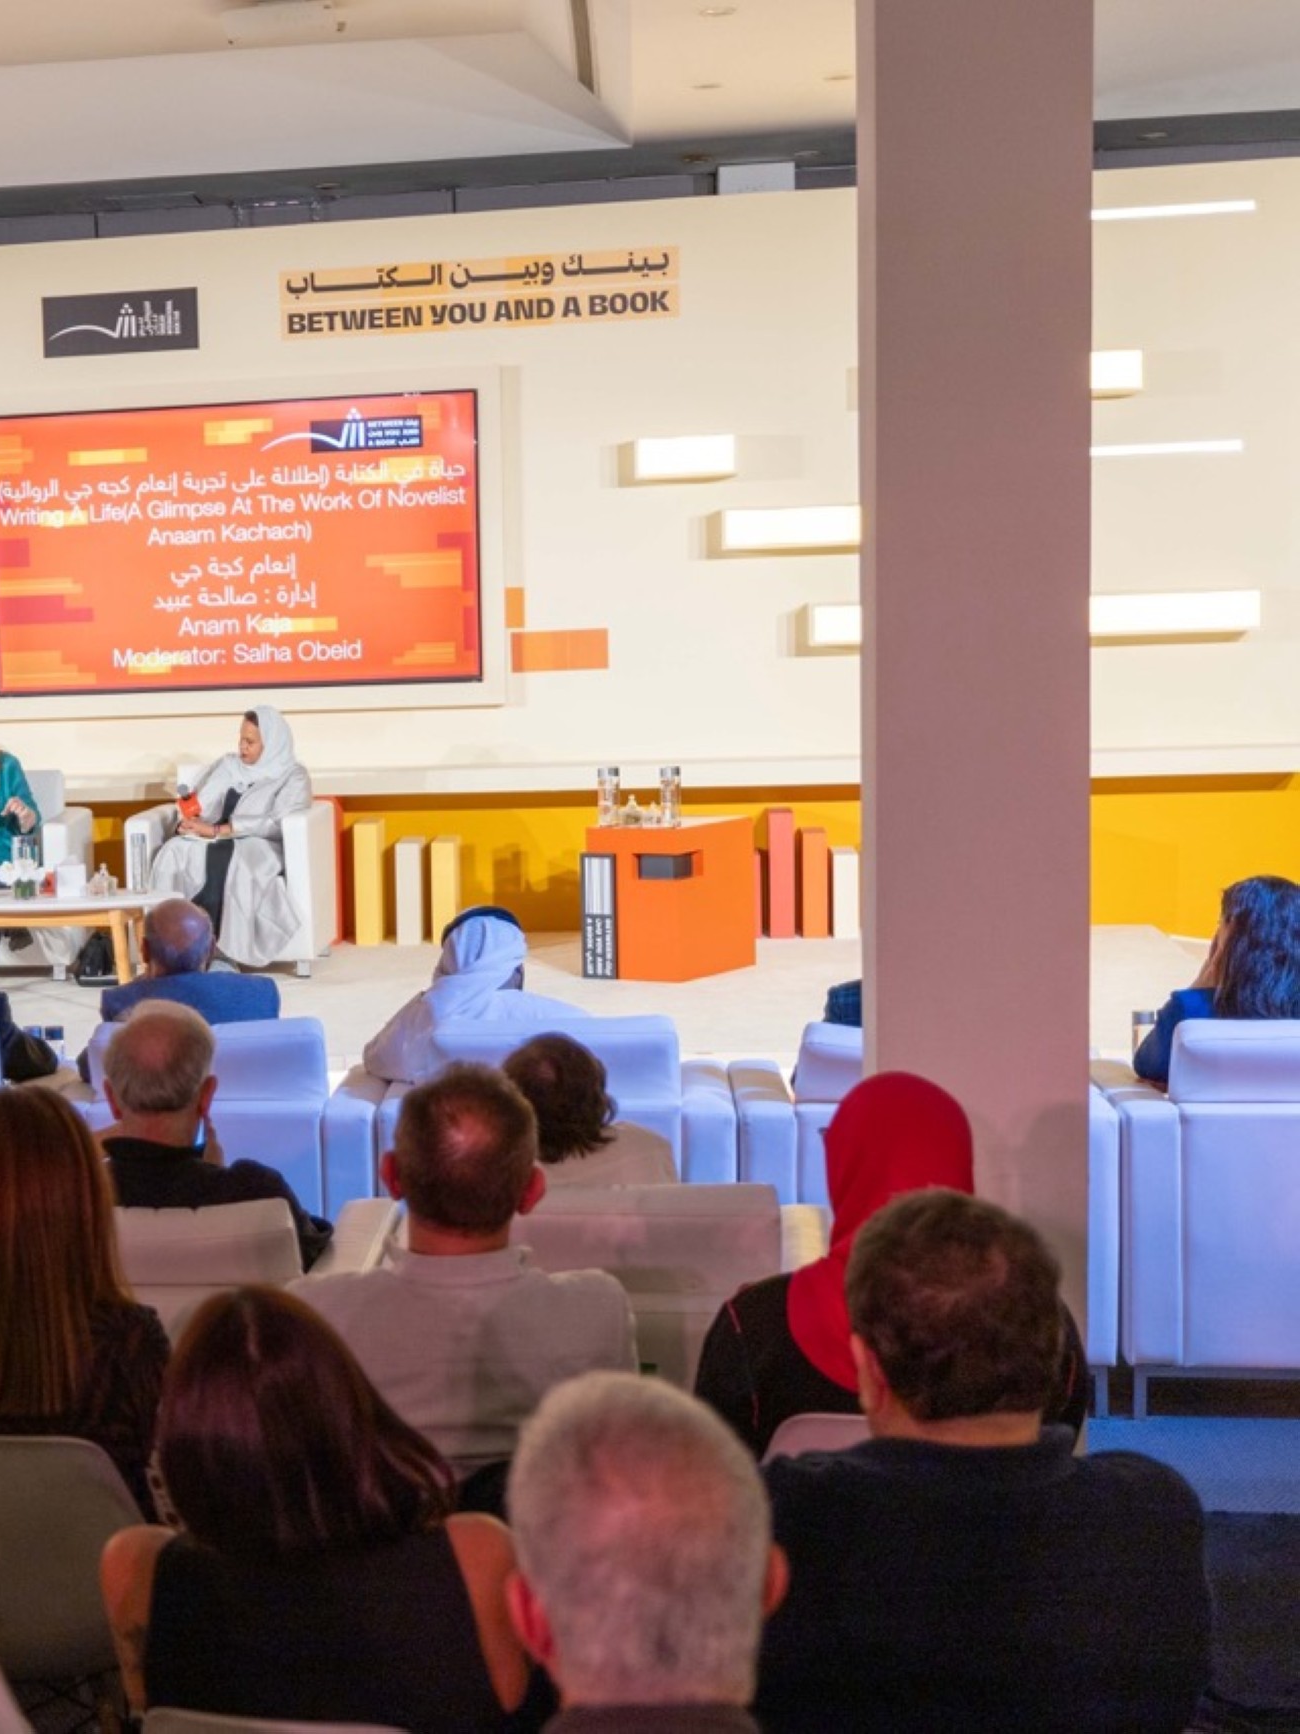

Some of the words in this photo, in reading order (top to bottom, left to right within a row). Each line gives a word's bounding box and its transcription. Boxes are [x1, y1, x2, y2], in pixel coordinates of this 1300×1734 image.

[287, 305, 423, 334] BETWEEN
[430, 302, 486, 326] YOU
[493, 298, 555, 322] AND
[561, 296, 582, 318] A
[588, 290, 670, 316] BOOK
[231, 468, 267, 493] على
[335, 461, 388, 484] الكتابة
[393, 465, 423, 488] في
[429, 458, 466, 480] حياة
[64, 483, 92, 505] جي
[98, 476, 131, 495] كجه
[136, 472, 178, 500] إنعام
[183, 471, 227, 494] تجربة
[69, 504, 85, 521] A
[147, 498, 225, 521] Glimpse
[232, 495, 252, 516] At
[258, 494, 295, 513] The
[299, 491, 353, 512] Work
[358, 489, 383, 509] Of
[388, 486, 466, 507] Novelist
[147, 526, 215, 546] Anaam
[221, 520, 312, 543] Kachach)
[170, 563, 203, 587] جي
[207, 556, 244, 580] كجة
[249, 553, 296, 583] إنعام
[153, 593, 193, 612] عبيد
[197, 585, 257, 606] صالحة
[276, 581, 317, 608] إدارة
[178, 617, 240, 636] Anam
[246, 613, 293, 637] Kaja
[113, 647, 227, 668] Moderator:
[233, 642, 292, 664] Salha
[298, 639, 362, 662] Obeid
